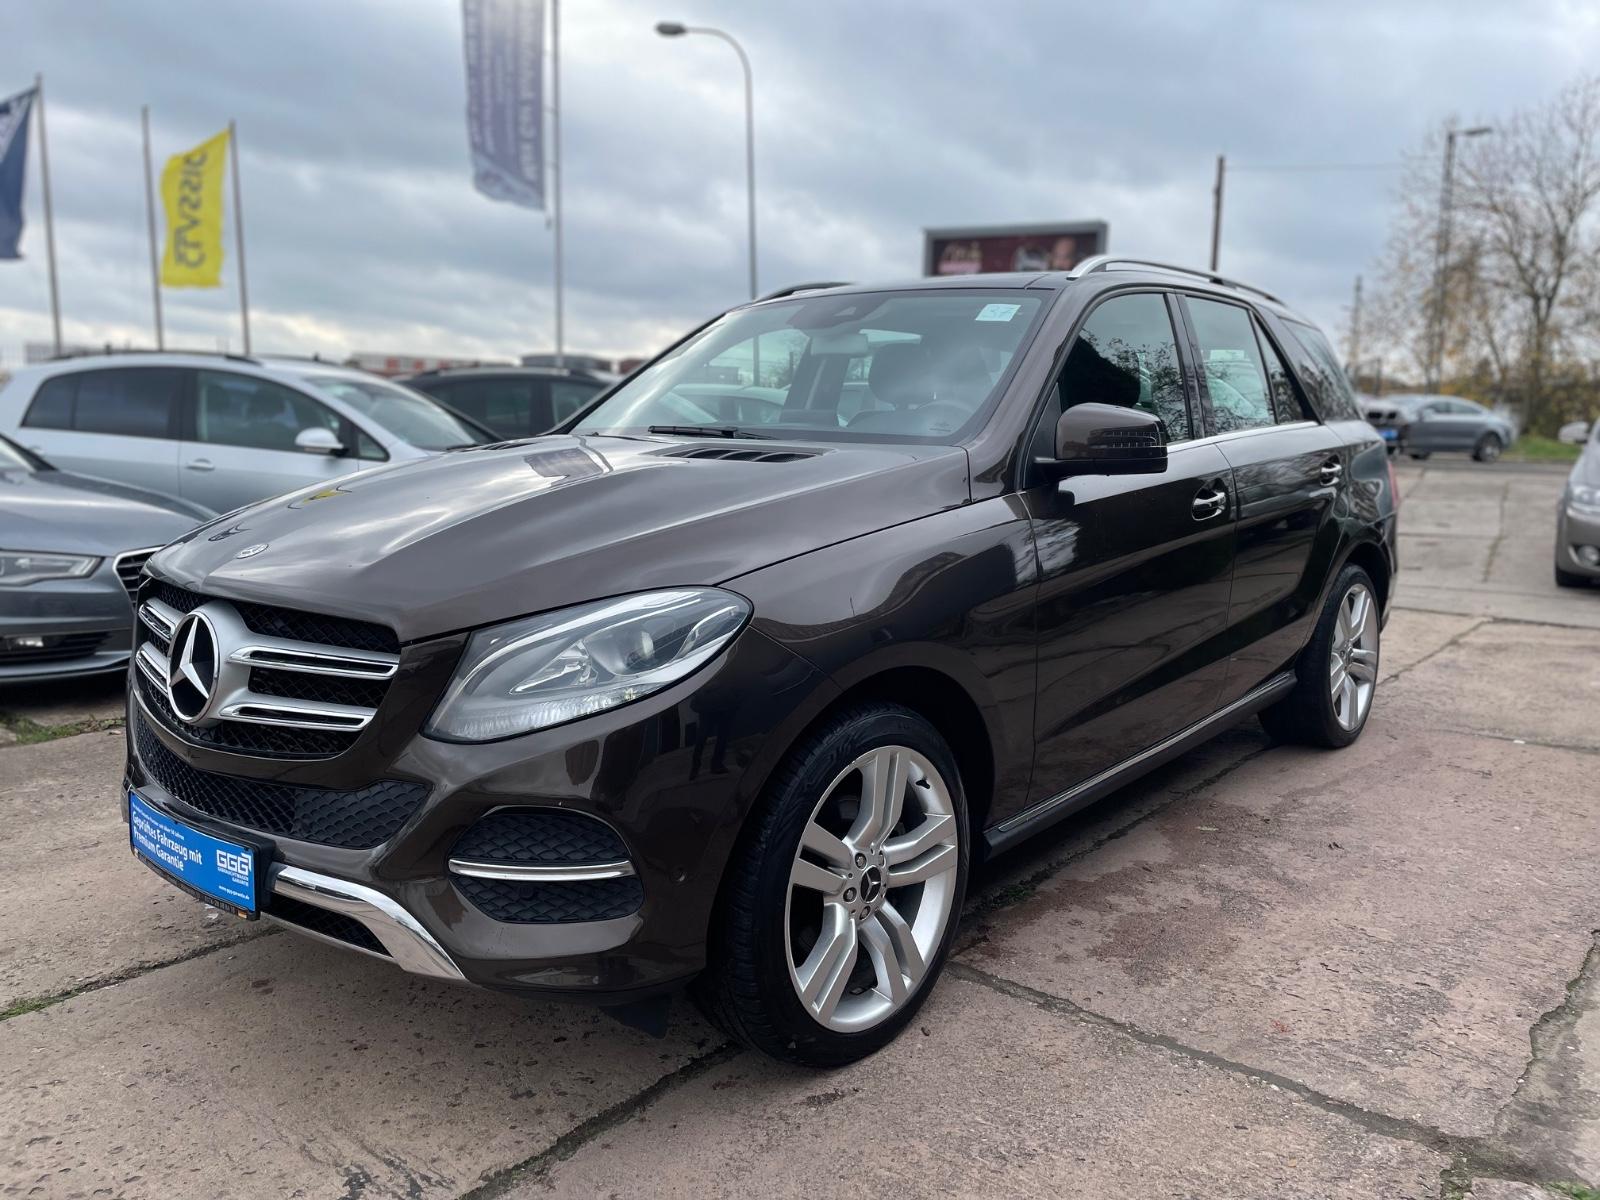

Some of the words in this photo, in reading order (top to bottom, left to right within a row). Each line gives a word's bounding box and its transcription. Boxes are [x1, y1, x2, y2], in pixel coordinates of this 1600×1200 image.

[133, 811, 156, 839] Geprüftes
[157, 829, 188, 860] Fahrzeug
[189, 850, 202, 865] mit
[134, 826, 156, 854] Premium
[156, 844, 184, 871] Garantie
[216, 850, 249, 876] GGG
